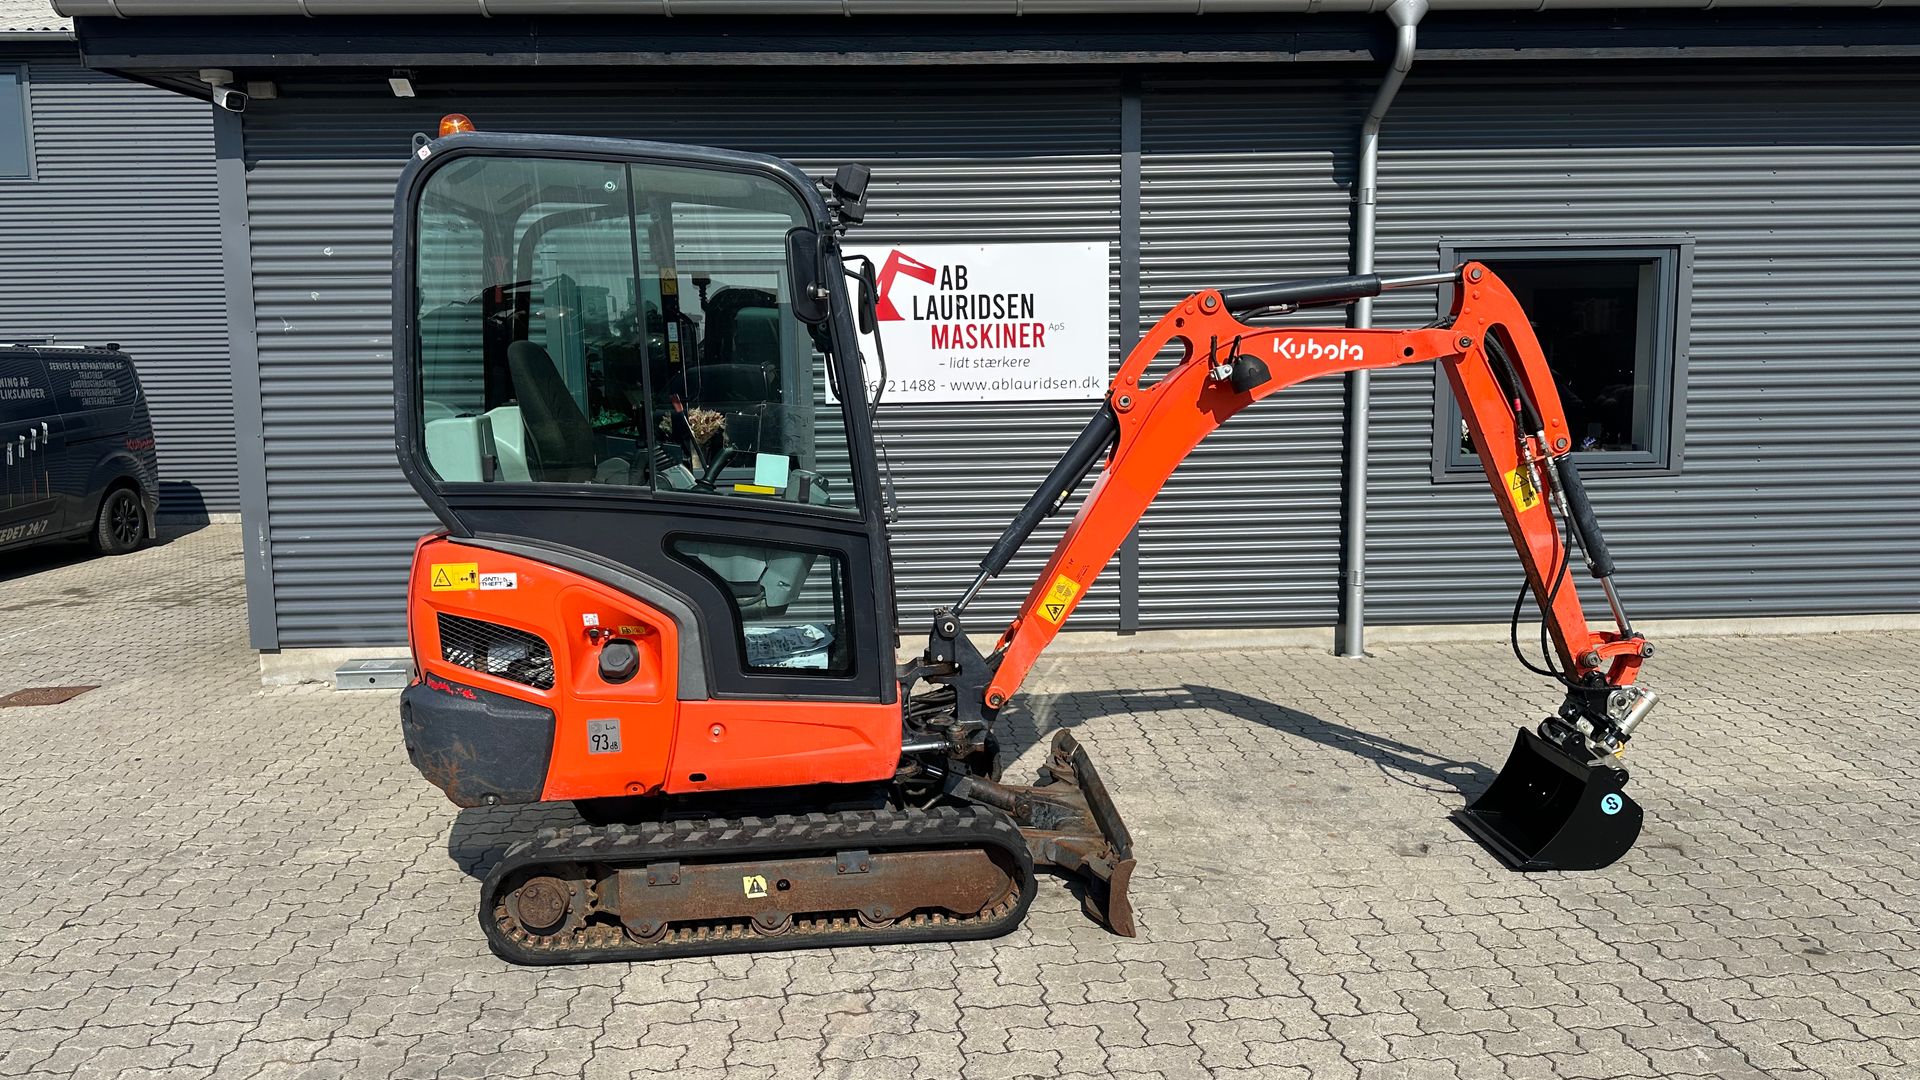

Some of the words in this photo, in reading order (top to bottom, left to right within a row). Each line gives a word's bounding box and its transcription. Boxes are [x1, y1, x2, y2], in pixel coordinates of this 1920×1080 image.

[940, 265, 968, 290] AB
[913, 293, 1034, 321] LAURIDSEN
[931, 323, 1046, 350] MASKINER
[1048, 322, 1065, 332] ApS
[1273, 337, 1364, 361] Kubota
[949, 356, 970, 369] lidt
[973, 356, 1031, 369] stærkere
[20, 376, 29, 387] AF
[901, 379, 936, 392] 1488
[949, 376, 1100, 391] www.ablauridsen.dk
[26, 519, 48, 536] 24/7
[592, 733, 609, 751] 93
[610, 741, 619, 750] dB
